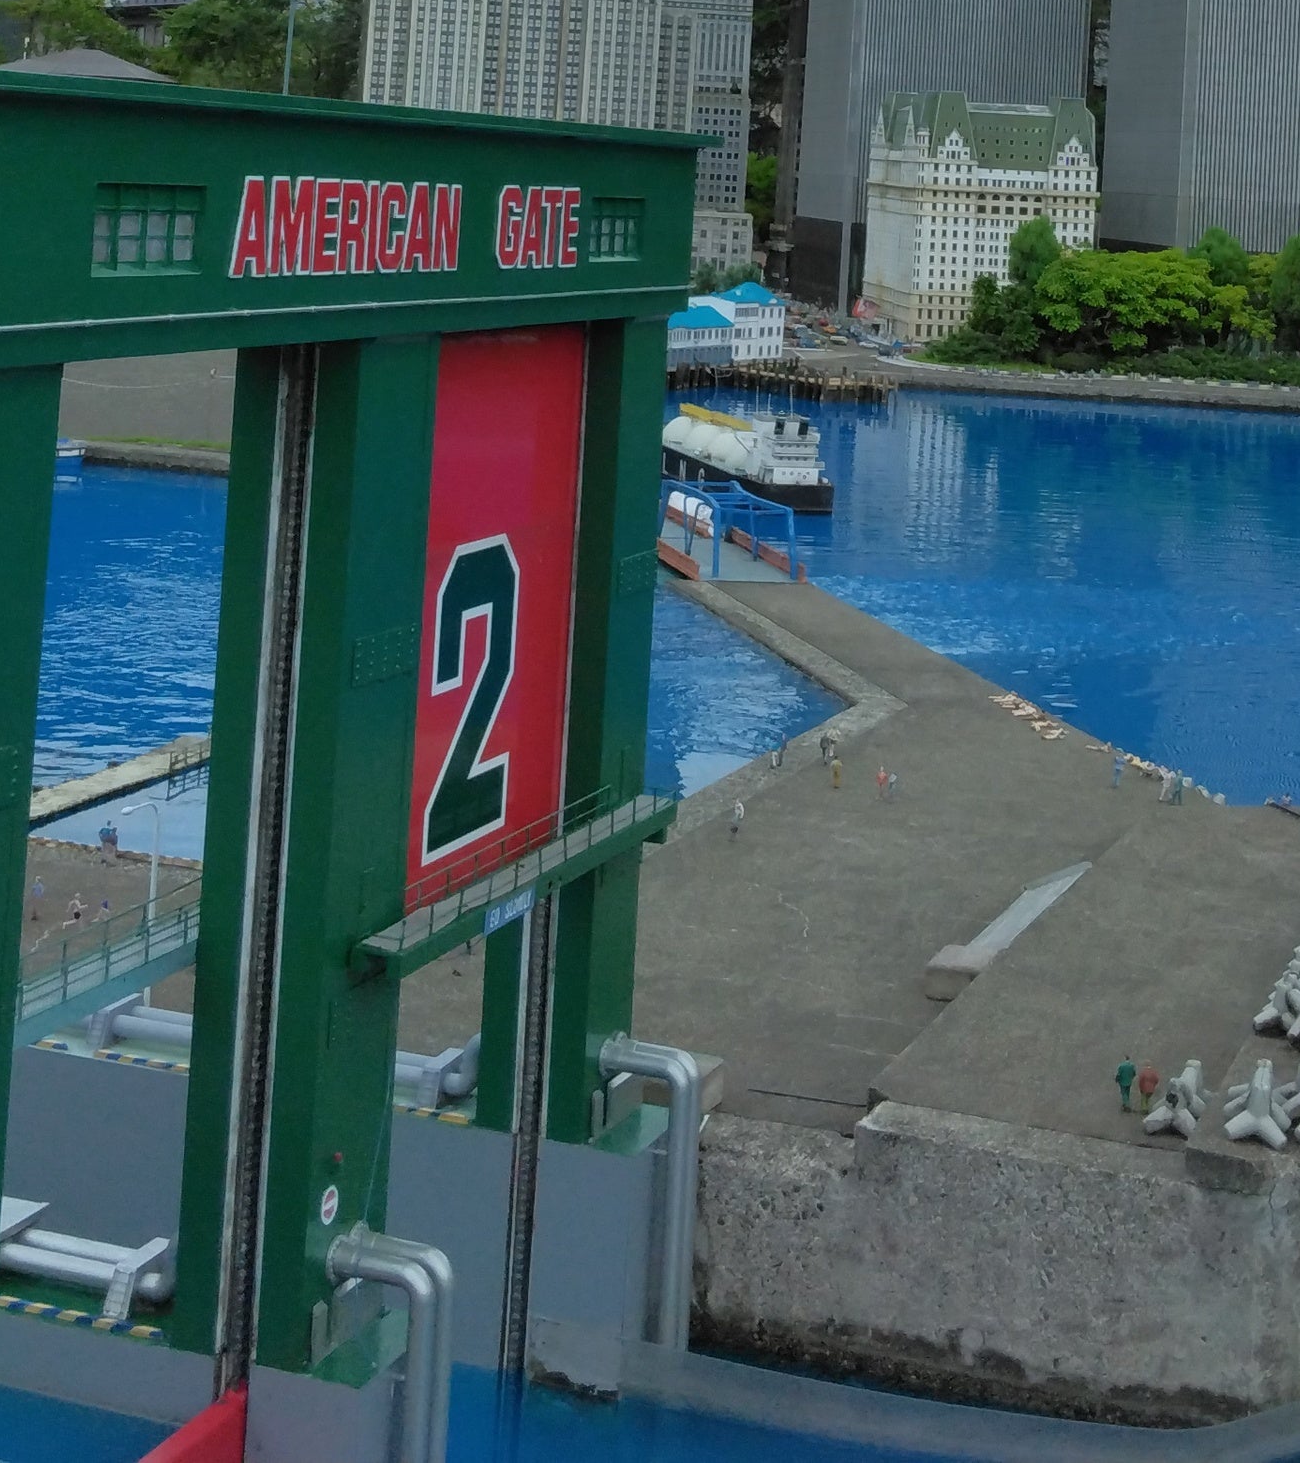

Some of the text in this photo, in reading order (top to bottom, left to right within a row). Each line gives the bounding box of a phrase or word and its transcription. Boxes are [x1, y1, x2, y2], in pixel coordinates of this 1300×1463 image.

[228, 175, 581, 278] AMERICAN GATE
[421, 533, 520, 867] 2
